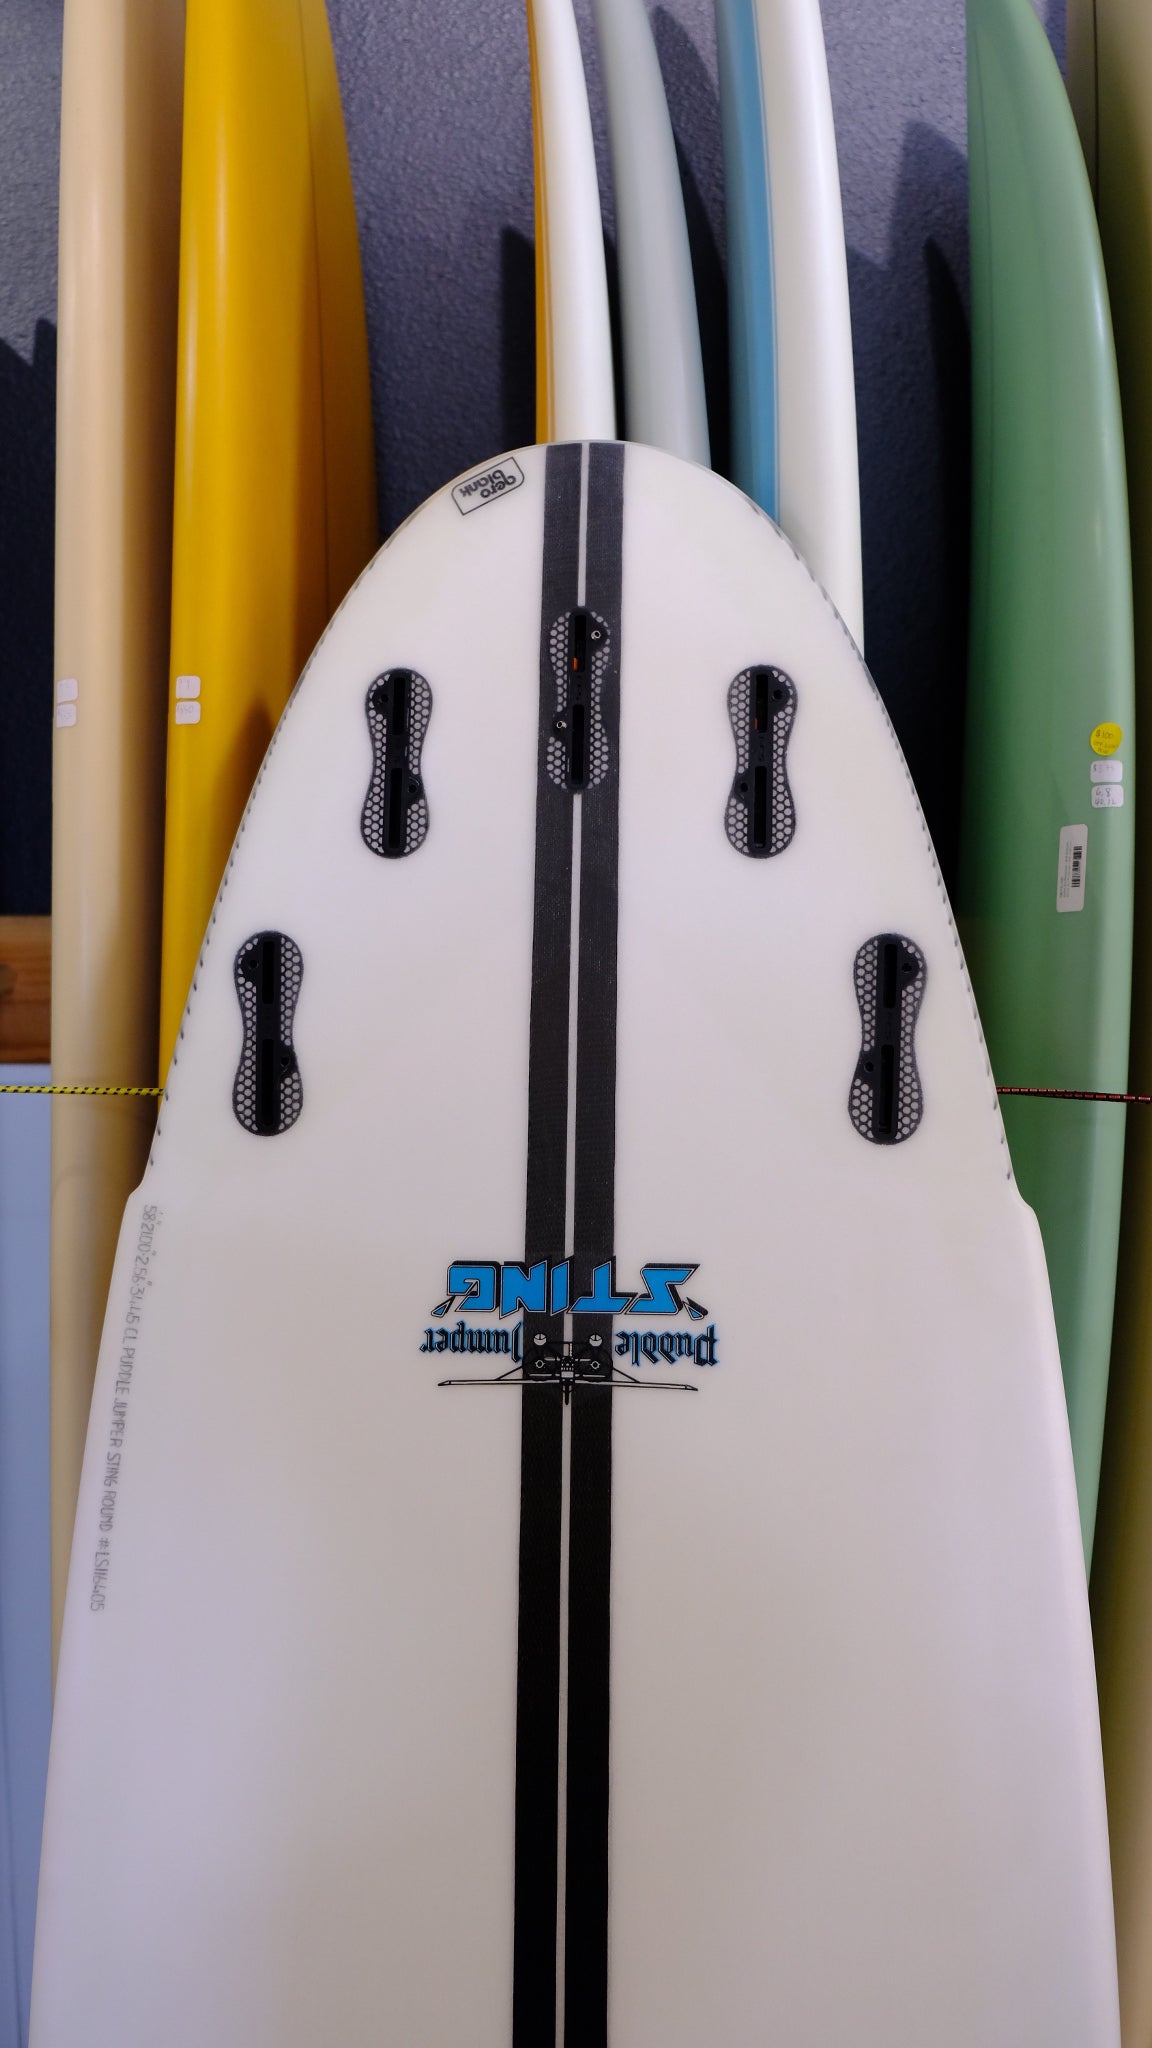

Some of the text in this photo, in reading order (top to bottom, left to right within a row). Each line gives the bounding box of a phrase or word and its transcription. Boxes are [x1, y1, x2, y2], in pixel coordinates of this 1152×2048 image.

[459, 469, 508, 498] blank
[480, 475, 517, 499] aero
[122, 1327, 138, 1345] CL
[419, 1320, 720, 1367] Puddle Jumper
[115, 1347, 136, 1396] PUDDLE
[109, 1397, 128, 1448] JUMPER
[103, 1452, 122, 1487] STING
[99, 1490, 117, 1532] ROUND
